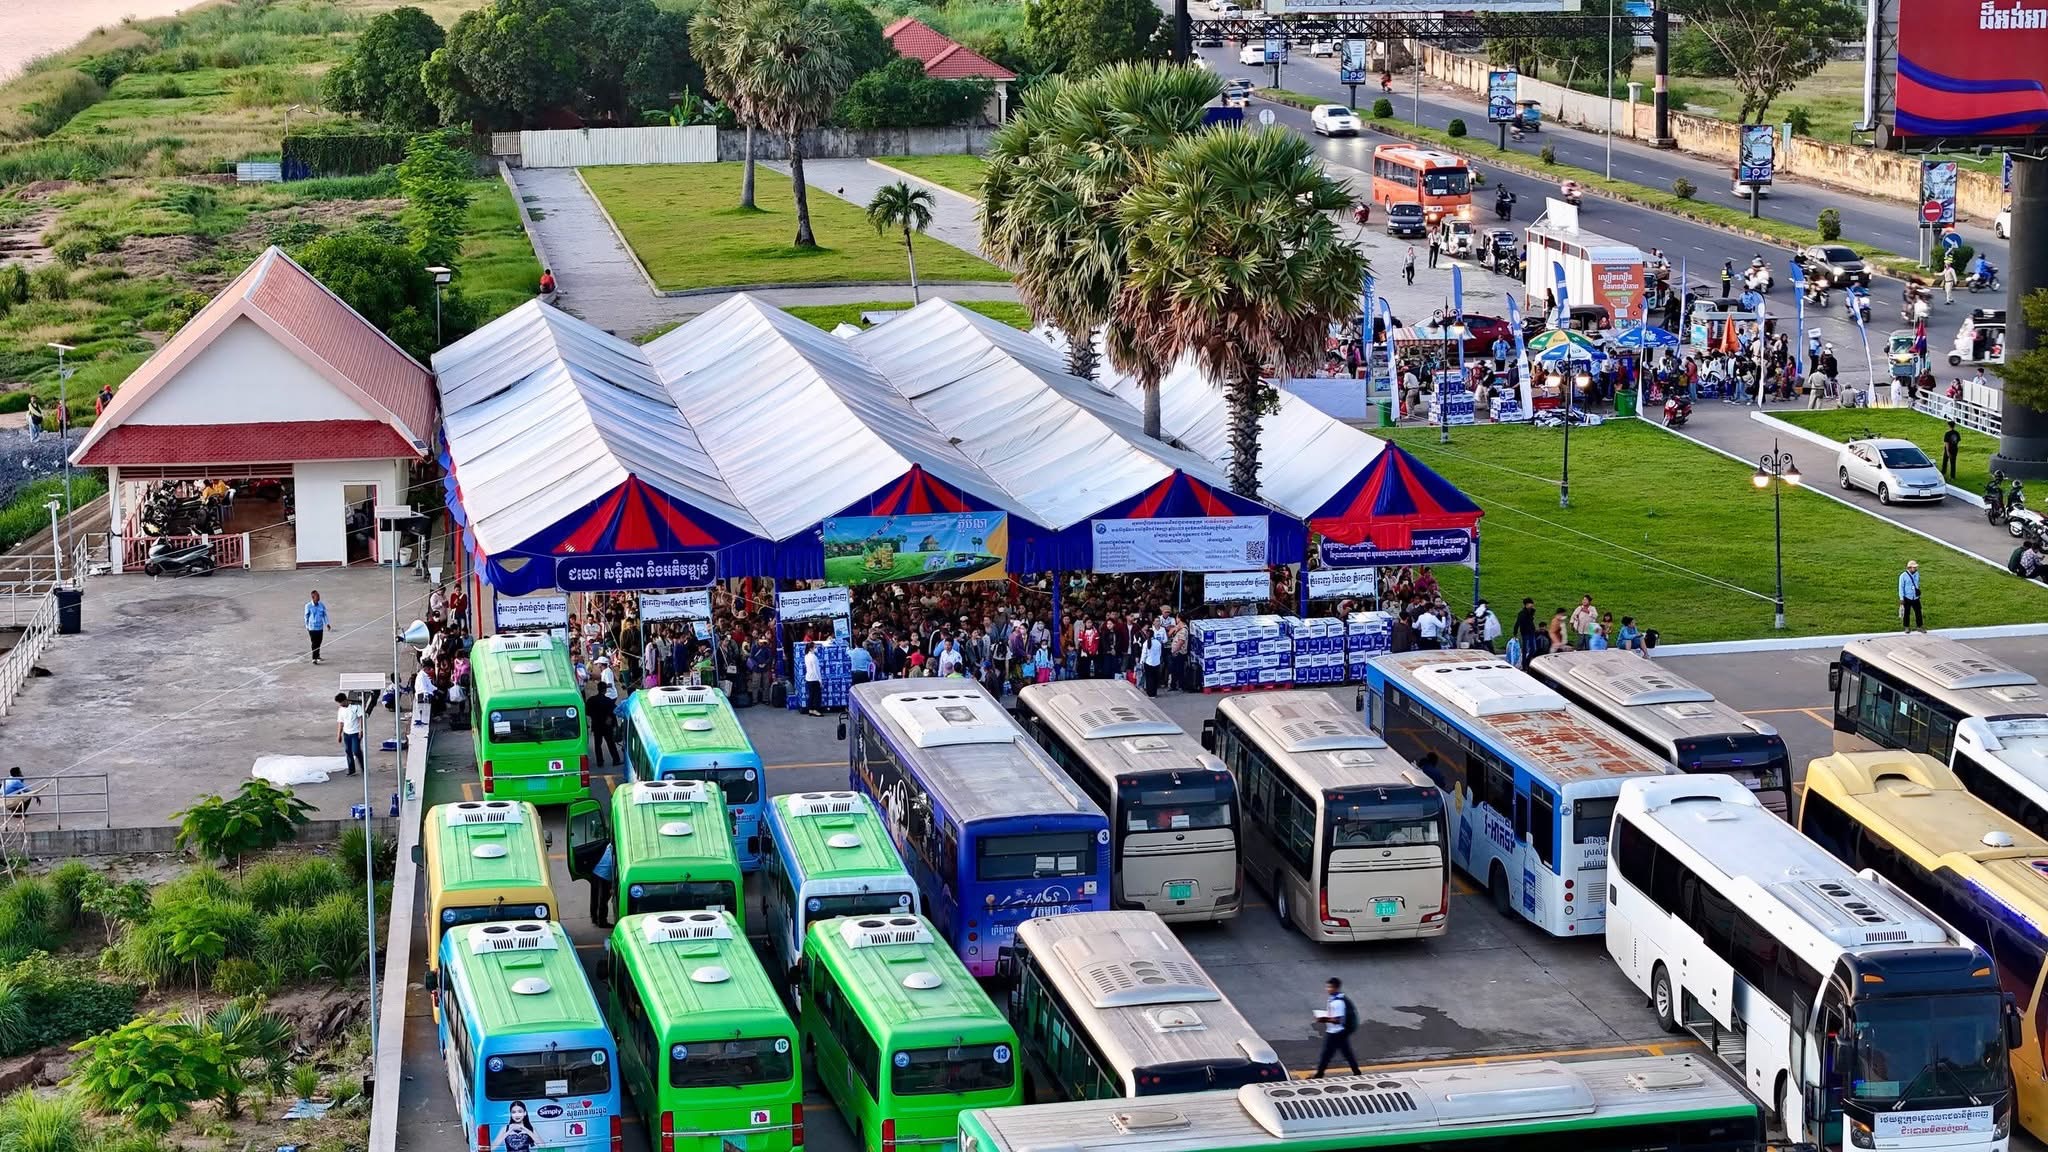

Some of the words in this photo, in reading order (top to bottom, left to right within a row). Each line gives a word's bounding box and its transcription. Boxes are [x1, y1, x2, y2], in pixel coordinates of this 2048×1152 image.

[568, 567, 601, 581] ជយោ!
[603, 561, 644, 584] សន្តិភាព
[646, 558, 709, 580] និងអភិវឌ្ឍន៍
[1101, 831, 1108, 841] 3
[902, 896, 907, 904] 3
[539, 907, 543, 915] 7
[777, 1040, 786, 1050] 1C
[594, 1052, 603, 1062] 1A
[996, 1048, 1007, 1060] 13
[540, 1107, 562, 1117] Simply
